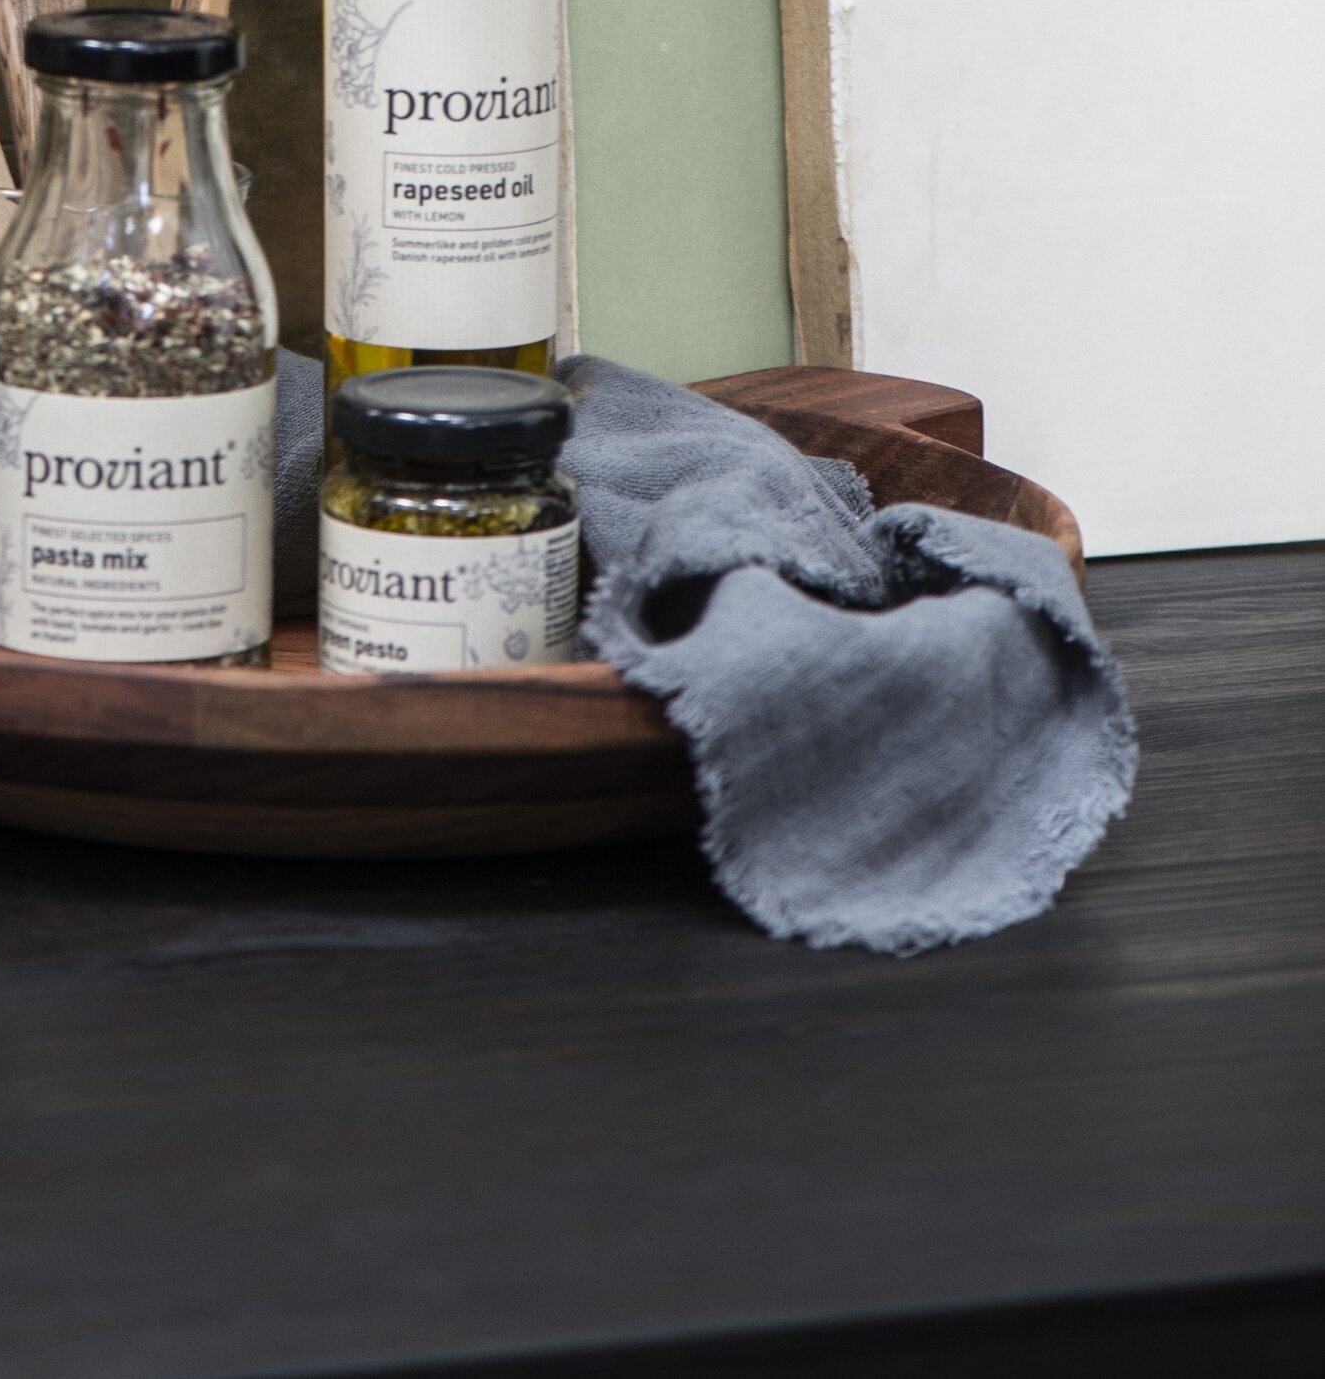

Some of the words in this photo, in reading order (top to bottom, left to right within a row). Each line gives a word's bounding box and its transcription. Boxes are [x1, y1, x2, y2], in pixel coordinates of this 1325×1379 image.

[383, 77, 557, 135] proviant
[393, 162, 433, 173] FINEST
[436, 163, 466, 174] COLD
[469, 162, 516, 173] PRESSED
[393, 177, 506, 206] rapeseed
[512, 174, 534, 198] oil
[393, 210, 421, 221] WITH
[424, 211, 465, 222] LEMON
[459, 238, 478, 249] and
[392, 250, 429, 262] Danish
[430, 251, 481, 265] rapeseed
[23, 446, 227, 498] proviant
[31, 545, 95, 569] pasta
[102, 548, 148, 569] mix
[355, 640, 408, 662] pesto
